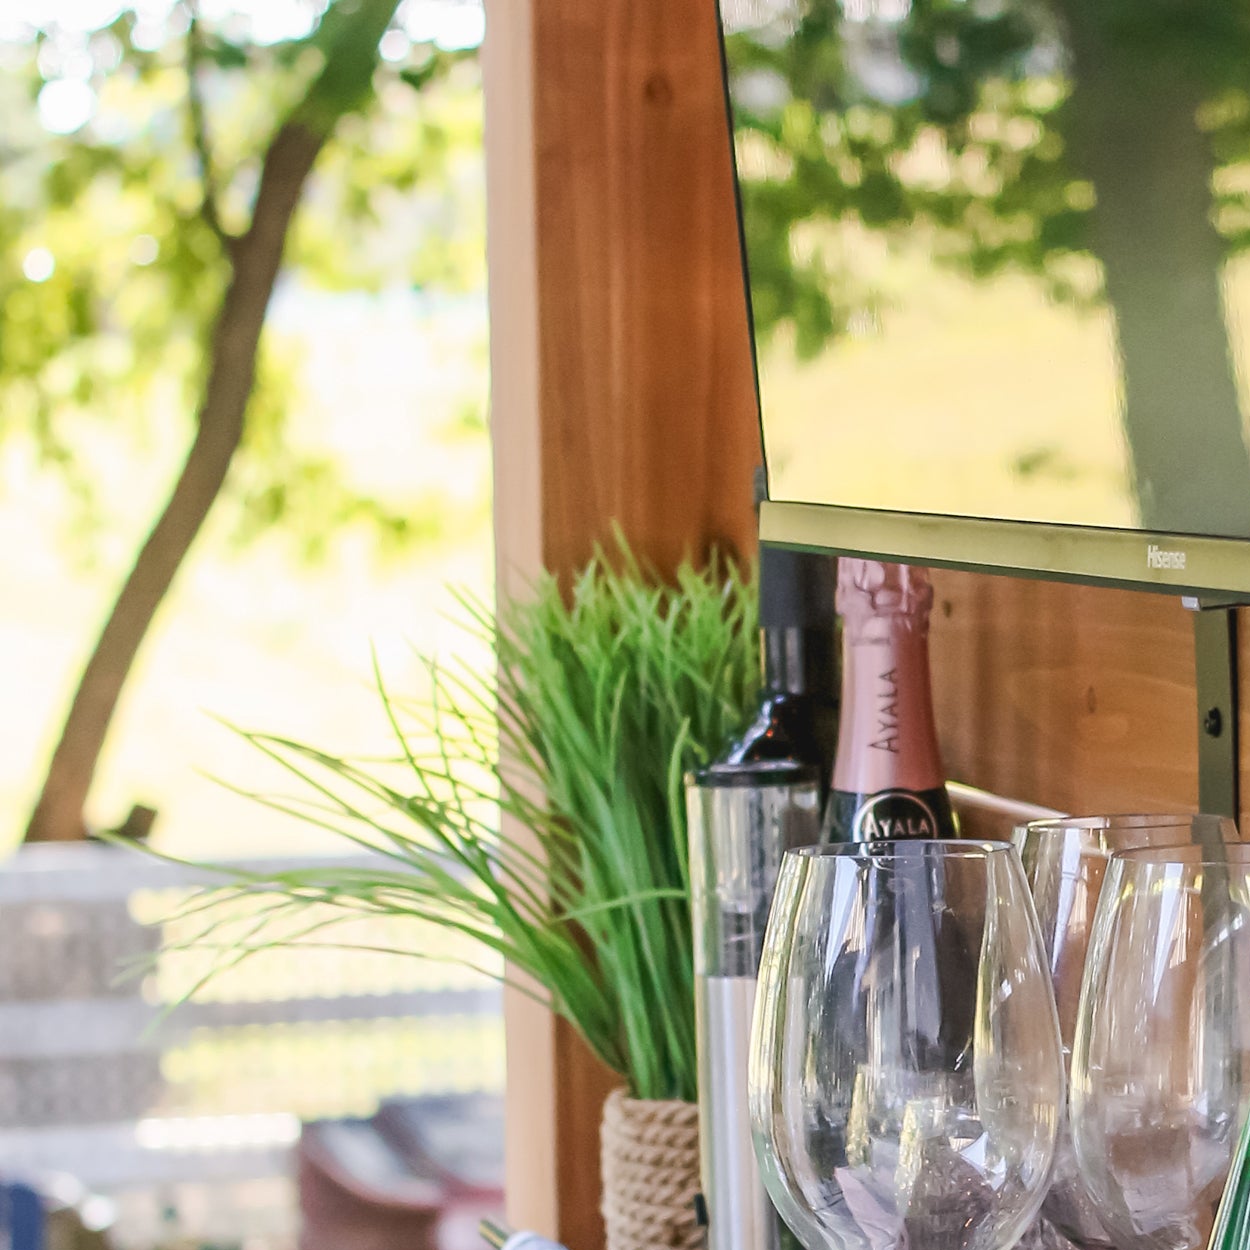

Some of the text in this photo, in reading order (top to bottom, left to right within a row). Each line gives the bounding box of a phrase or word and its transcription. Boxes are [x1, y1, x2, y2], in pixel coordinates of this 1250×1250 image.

[1146, 544, 1186, 570] Hisense
[868, 668, 900, 753] AYALA
[863, 811, 931, 838] AYALA
